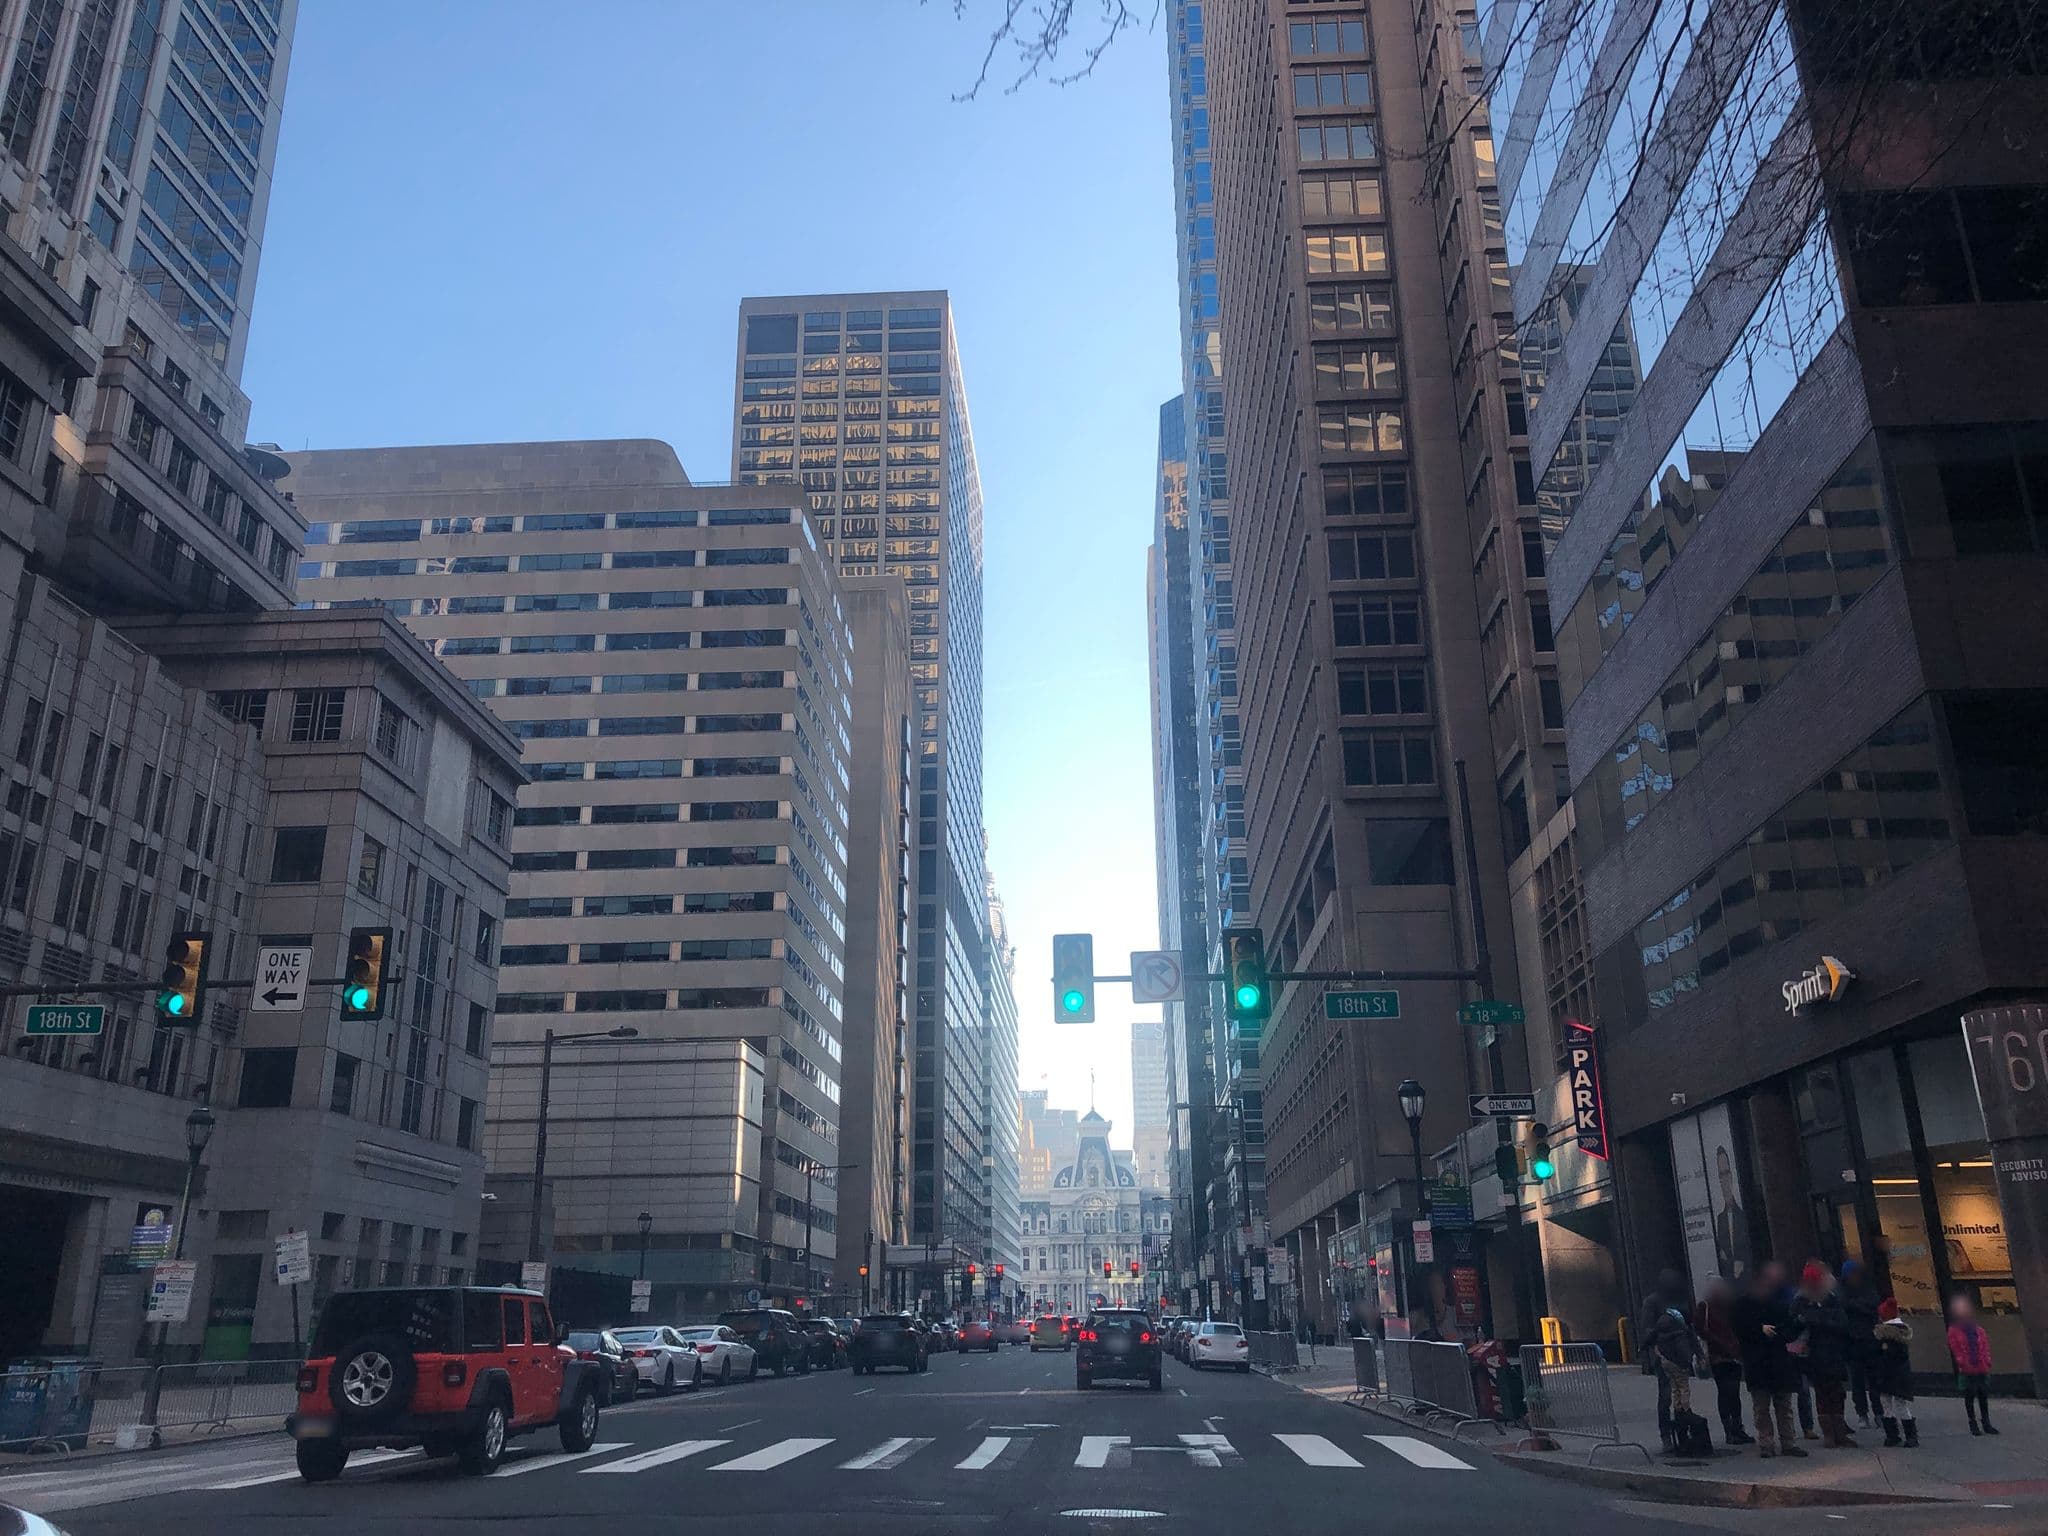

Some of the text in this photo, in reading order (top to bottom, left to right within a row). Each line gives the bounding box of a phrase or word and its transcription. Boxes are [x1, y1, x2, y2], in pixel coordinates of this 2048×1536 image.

[269, 953, 301, 967] ONE
[265, 970, 301, 984] WAY
[1782, 966, 1824, 1017] Sprint
[1337, 997, 1387, 1013] 18th St
[40, 1011, 91, 1028] 18th St
[1512, 1010, 1521, 1020] ST
[1572, 1049, 1597, 1129] PARK
[1489, 1100, 1528, 1110] ONE WAY
[2000, 1160, 2043, 1171] SECURITY
[797, 1249, 804, 1260] P
